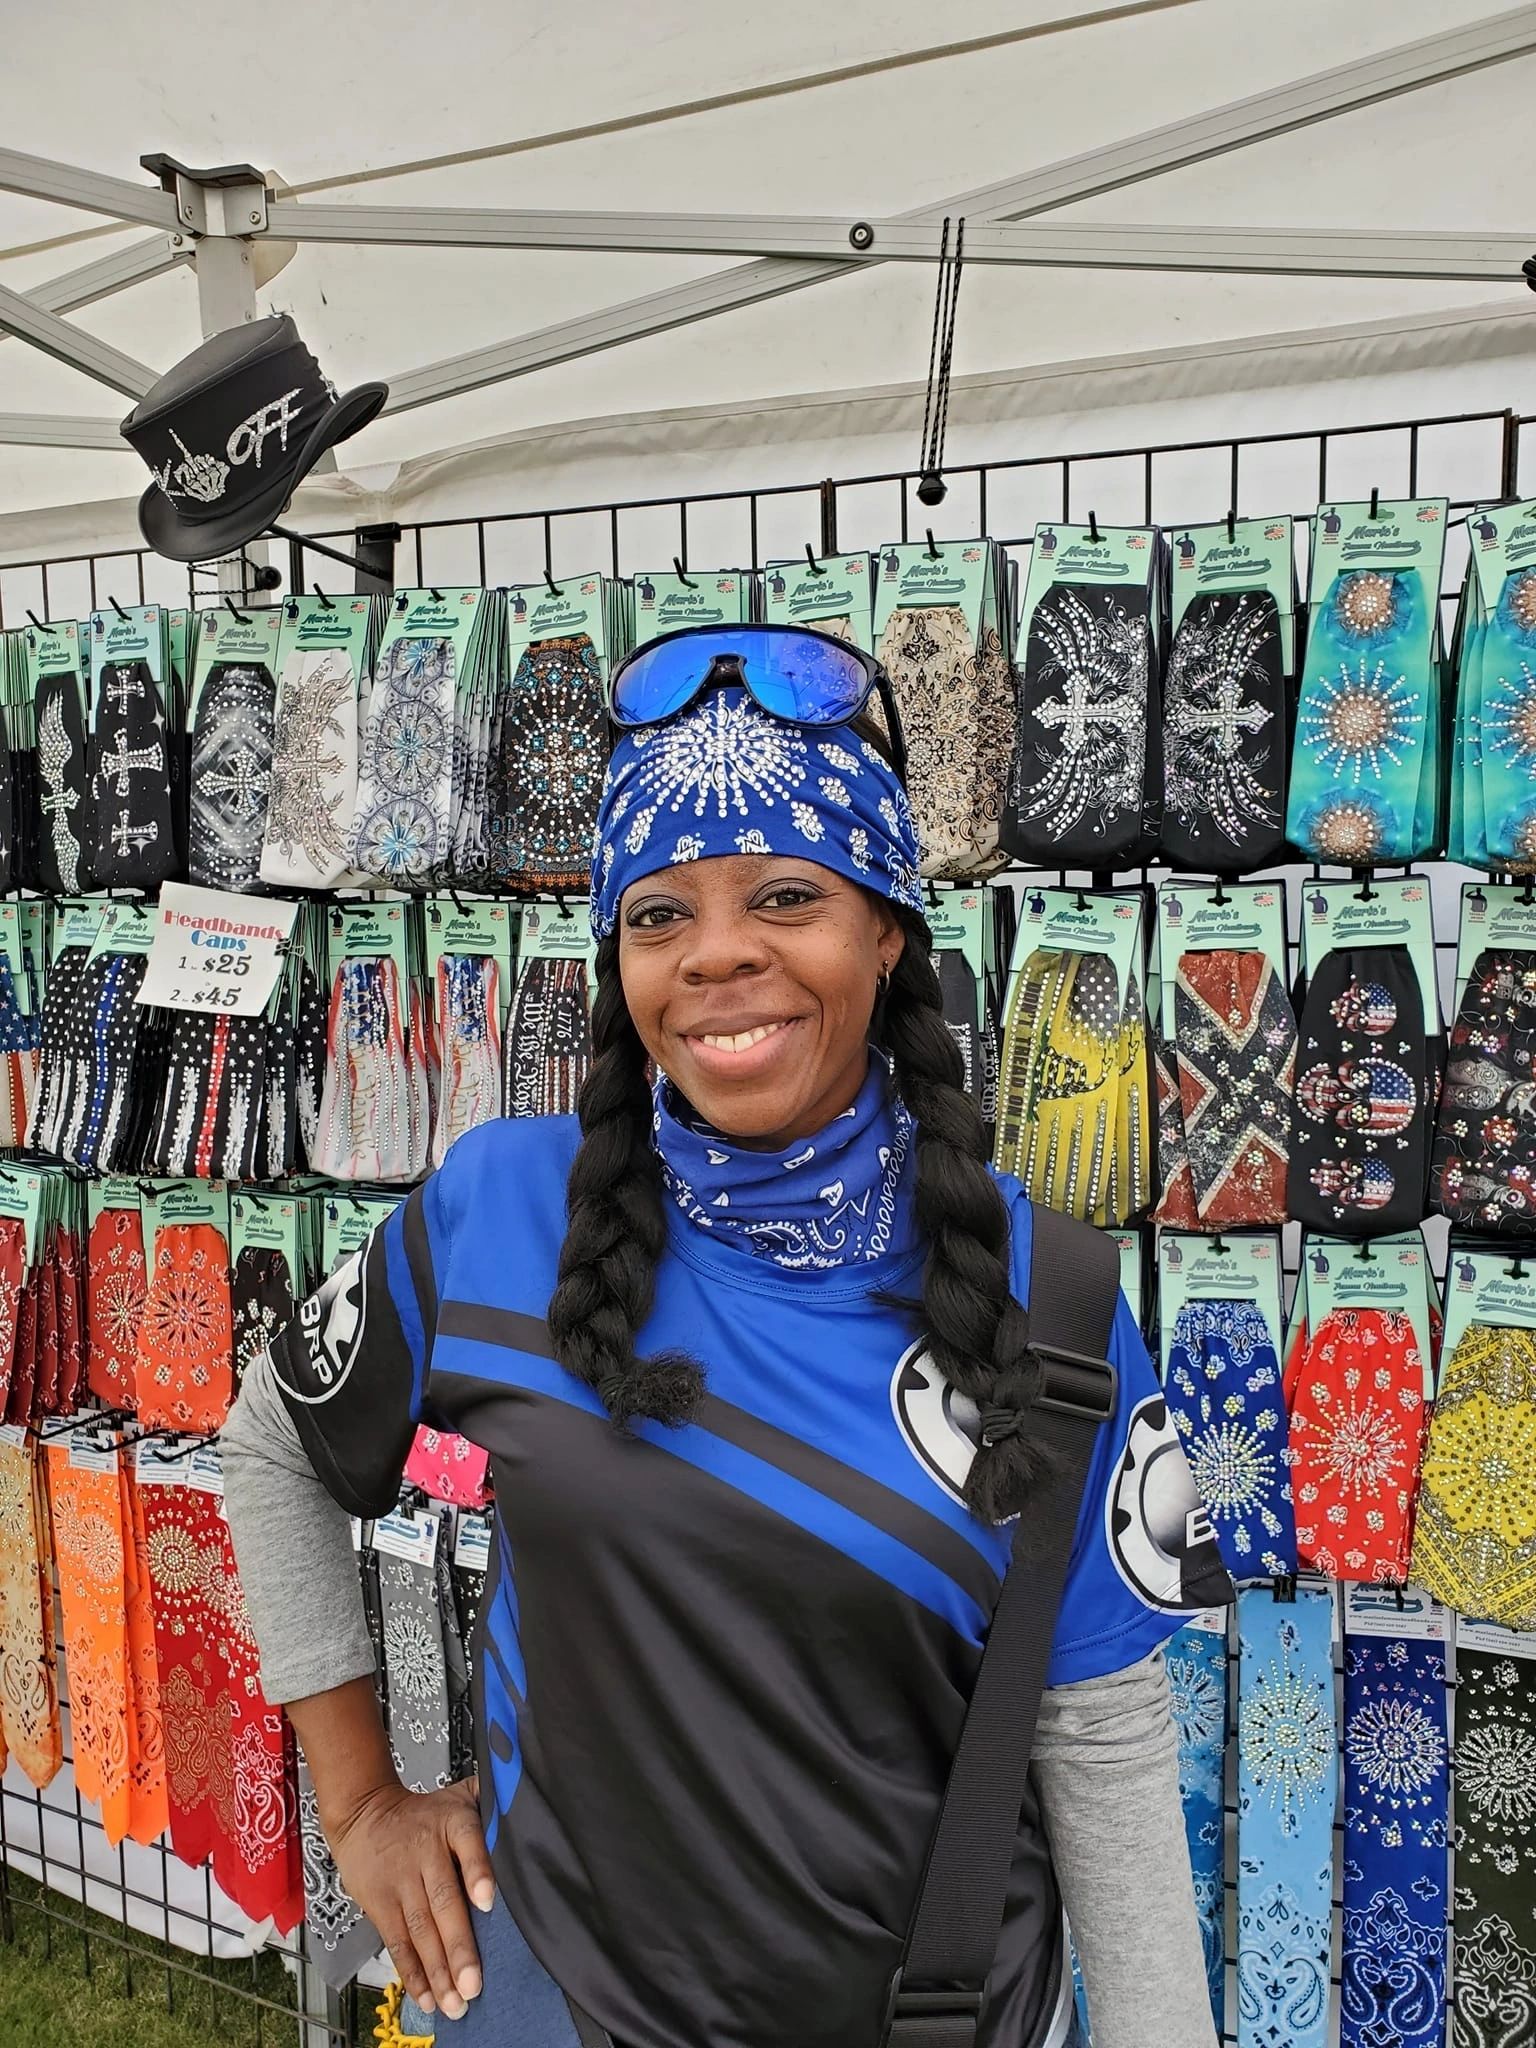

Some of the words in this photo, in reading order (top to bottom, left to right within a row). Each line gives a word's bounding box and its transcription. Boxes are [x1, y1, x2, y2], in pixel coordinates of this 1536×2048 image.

[226, 388, 304, 468] OFF
[164, 909, 284, 940] Headbands
[191, 930, 248, 952] Caps
[178, 956, 187, 969] 1
[202, 953, 252, 976] $25
[169, 989, 181, 1002] 2
[191, 986, 242, 1006] $45
[557, 1010, 573, 1039] 1776
[511, 1062, 539, 1118] Peopl
[1007, 1095, 1024, 1117] ON
[300, 1294, 334, 1385] BRP
